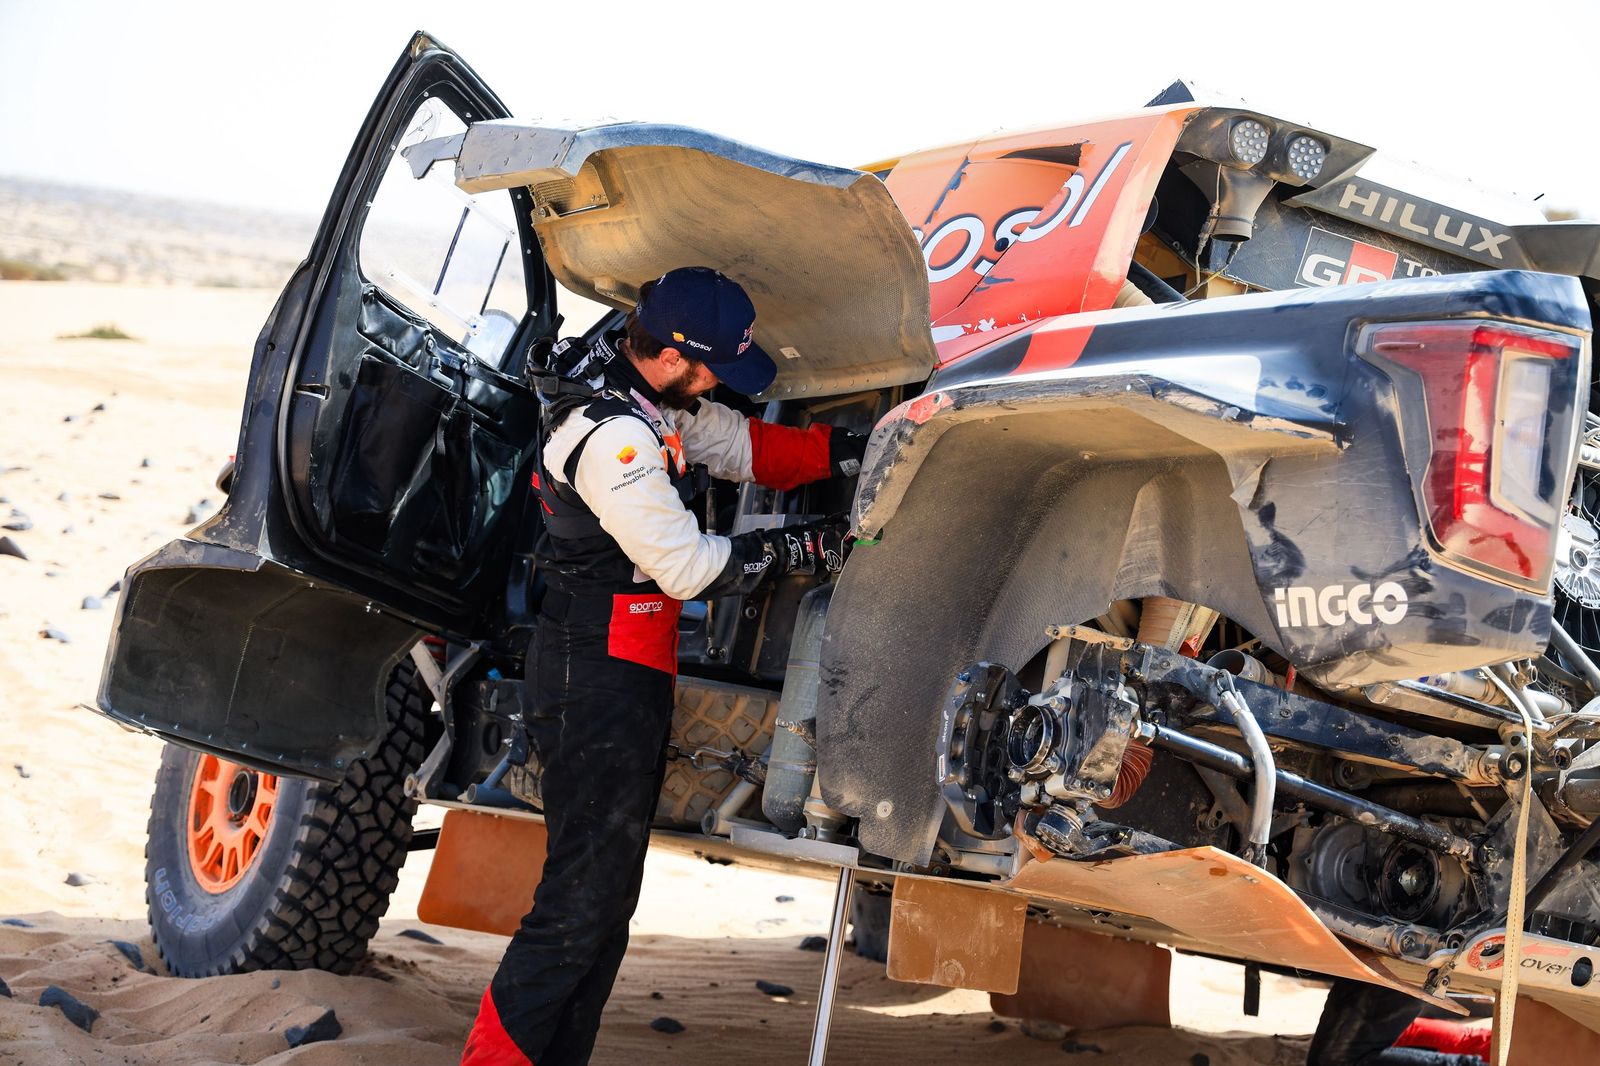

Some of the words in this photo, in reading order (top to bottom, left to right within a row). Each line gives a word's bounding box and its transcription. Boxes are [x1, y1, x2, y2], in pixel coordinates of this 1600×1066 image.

[1338, 184, 1511, 260] HILUX
[686, 339, 713, 352] repsol
[610, 472, 646, 492] renewable
[743, 554, 773, 574] sparco
[629, 601, 663, 614] sparco
